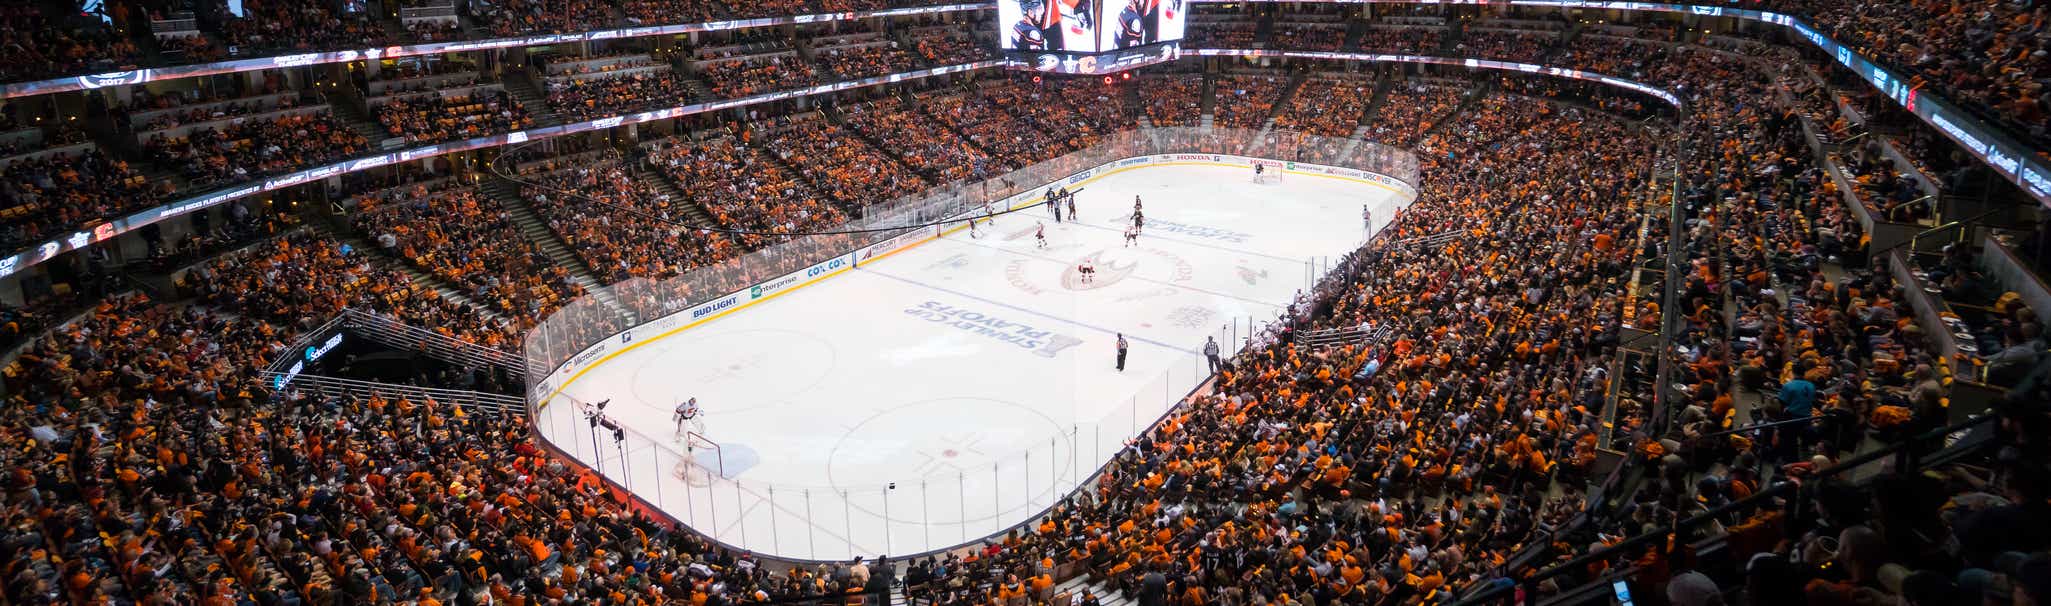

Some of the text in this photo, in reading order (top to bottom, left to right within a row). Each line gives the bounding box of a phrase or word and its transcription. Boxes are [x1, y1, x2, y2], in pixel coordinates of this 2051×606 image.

[1070, 171, 1091, 184] GEICO
[808, 258, 846, 277] COX COX
[693, 297, 737, 318] BUD LIGHT
[904, 308, 1043, 349] STANLEY CUP
[918, 301, 1052, 339] PLAYOFFS
